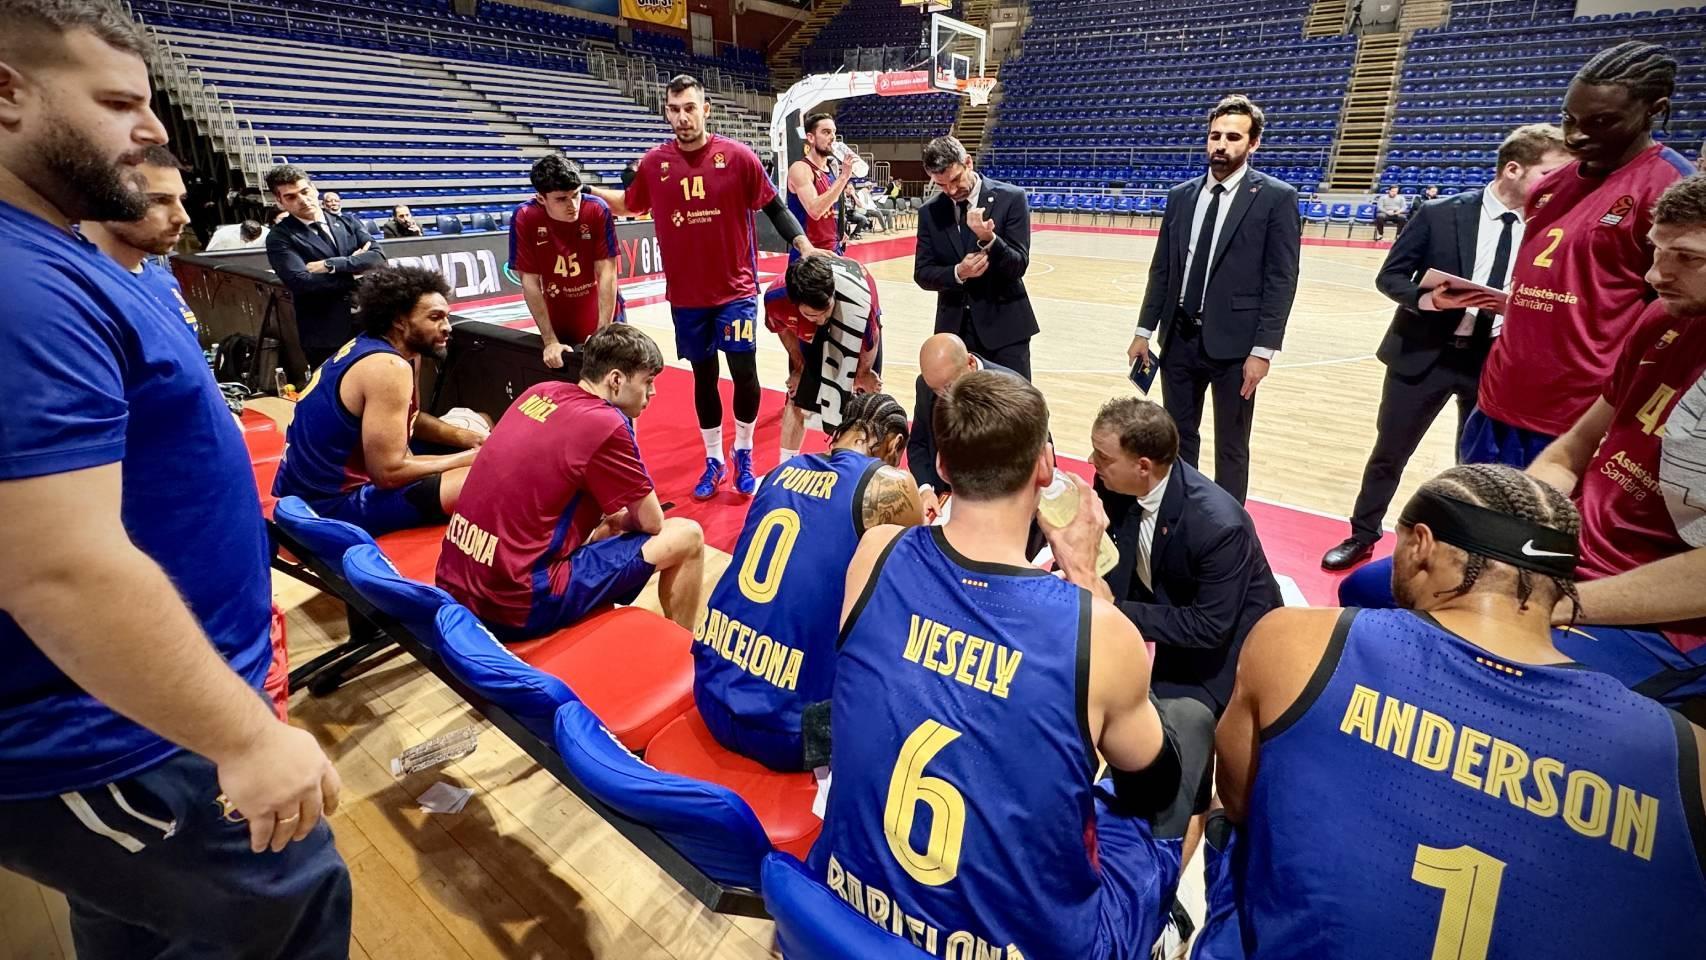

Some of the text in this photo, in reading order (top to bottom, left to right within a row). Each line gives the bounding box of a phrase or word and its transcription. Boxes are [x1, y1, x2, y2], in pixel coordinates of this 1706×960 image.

[680, 176, 706, 200] 14
[553, 252, 581, 278] 45
[1532, 227, 1564, 268] 2
[1516, 283, 1578, 305] Assistència
[731, 319, 753, 342] 14
[1634, 382, 1678, 439] 4
[772, 466, 839, 500] PUNTER
[445, 511, 499, 568] CELONA
[738, 507, 801, 604] 0
[902, 614, 1023, 698] VESELY
[1339, 683, 1660, 862] ANDERSON
[883, 718, 966, 887] 6
[1411, 843, 1508, 960] 1
